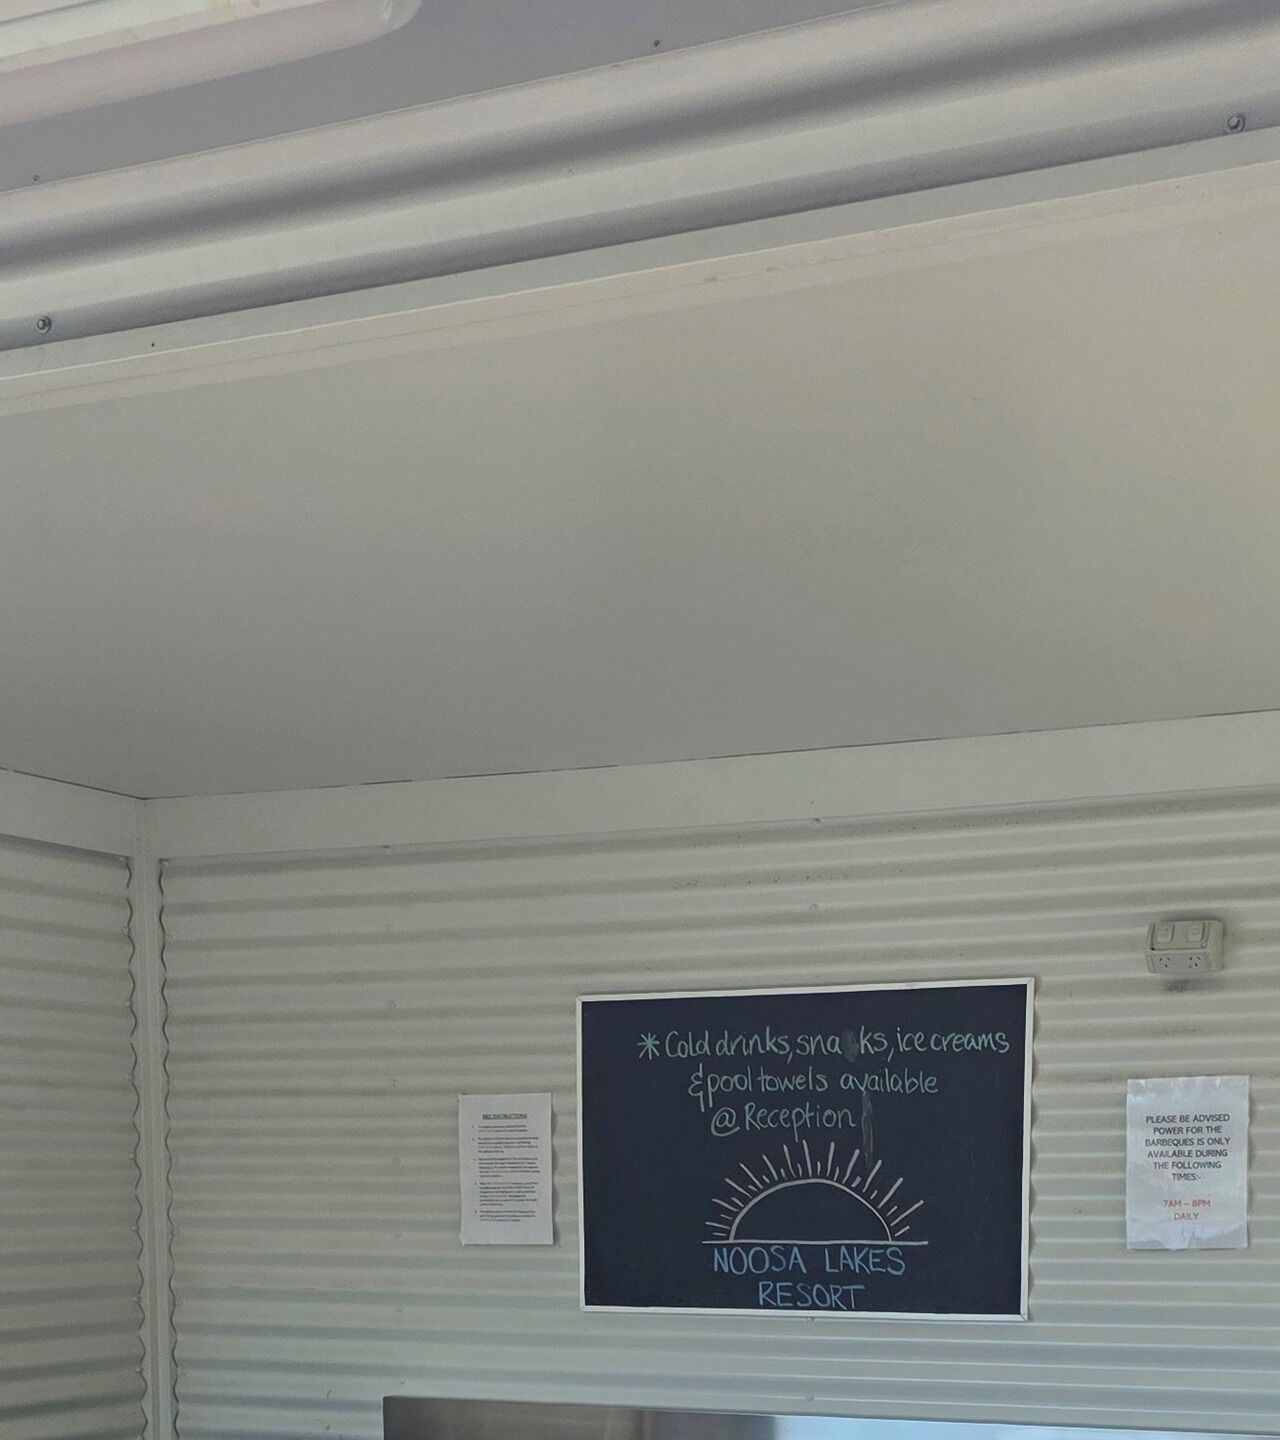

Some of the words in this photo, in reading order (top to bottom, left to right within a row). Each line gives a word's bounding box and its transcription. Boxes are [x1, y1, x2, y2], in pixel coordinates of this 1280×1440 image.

[665, 1030, 711, 1058] Cold
[715, 1025, 793, 1064] drinks,
[796, 1025, 894, 1062] snaks,
[897, 1027, 928, 1052] ice
[930, 1031, 1010, 1053] creams
[707, 1065, 752, 1108] pool
[757, 1065, 828, 1092] towels
[840, 1068, 939, 1095] available
[710, 1107, 741, 1137] @
[744, 1101, 856, 1143] Reception
[1145, 1114, 1177, 1124] PLEASE
[1179, 1114, 1190, 1123] BE
[1192, 1113, 1231, 1123] ADVISED
[1153, 1127, 1184, 1135] POWER
[1186, 1126, 1203, 1135] FOR
[1206, 1125, 1223, 1134] THE
[1145, 1138, 1195, 1147] BARBEQUES
[1197, 1137, 1205, 1146] IS
[1206, 1136, 1231, 1146] ONLY
[1147, 1149, 1193, 1158] AVAILABLE
[1195, 1148, 1228, 1158] DURING
[1153, 1161, 1169, 1170] THE
[1171, 1160, 1222, 1170] FOLLOWING
[1162, 1199, 1182, 1208] 7AM
[1173, 1211, 1200, 1221] DAILY
[713, 1245, 807, 1275] NOOSA
[824, 1245, 906, 1276] LAKES
[758, 1281, 865, 1310] RESORT
